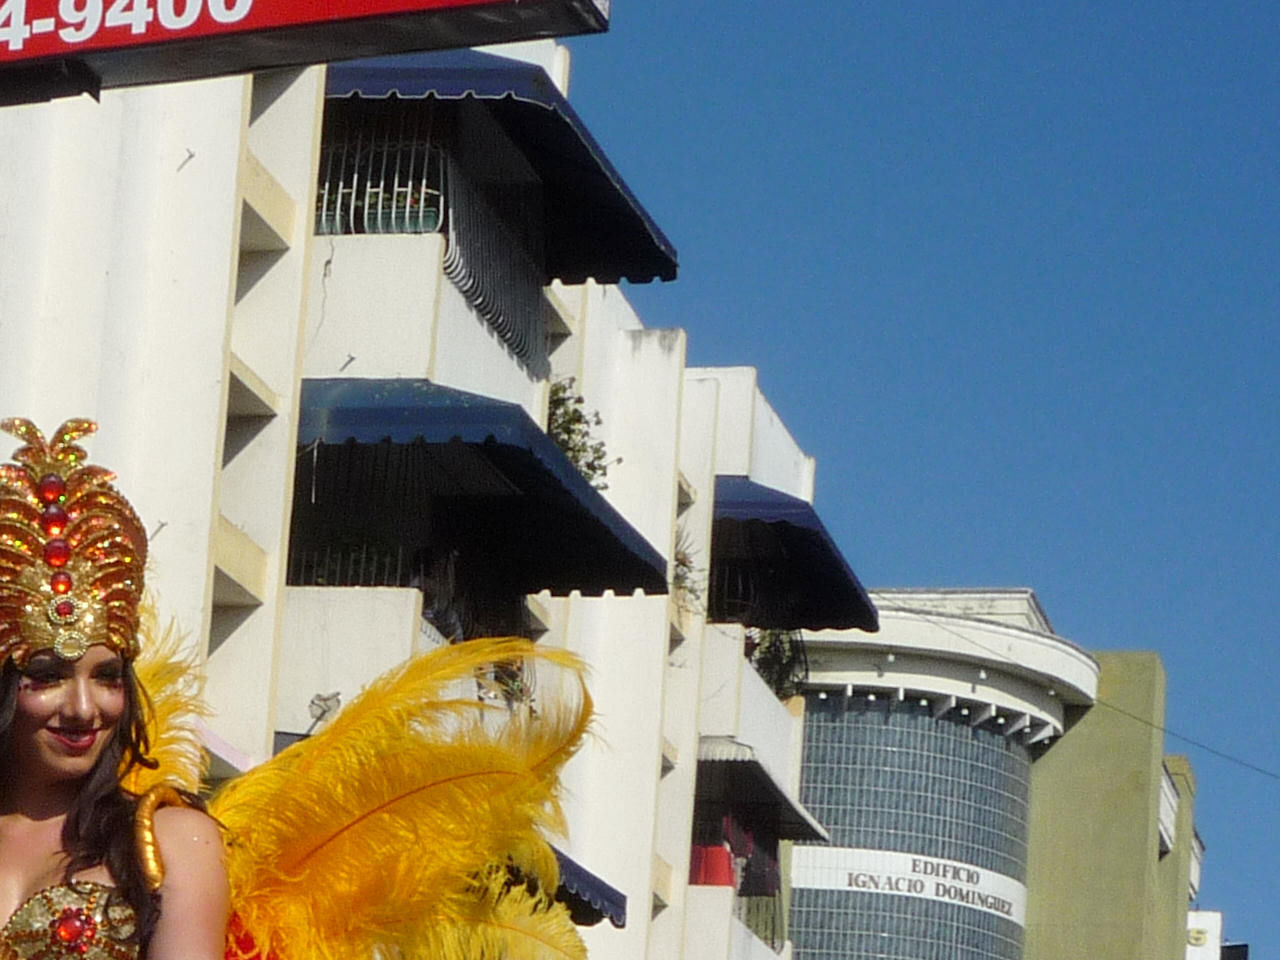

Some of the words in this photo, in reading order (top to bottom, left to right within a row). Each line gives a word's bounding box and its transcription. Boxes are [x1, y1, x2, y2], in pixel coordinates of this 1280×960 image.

[911, 858, 980, 885] EDIFICIO
[847, 872, 925, 894] IGNACIO
[934, 882, 1013, 916] DOMINGUEZ
